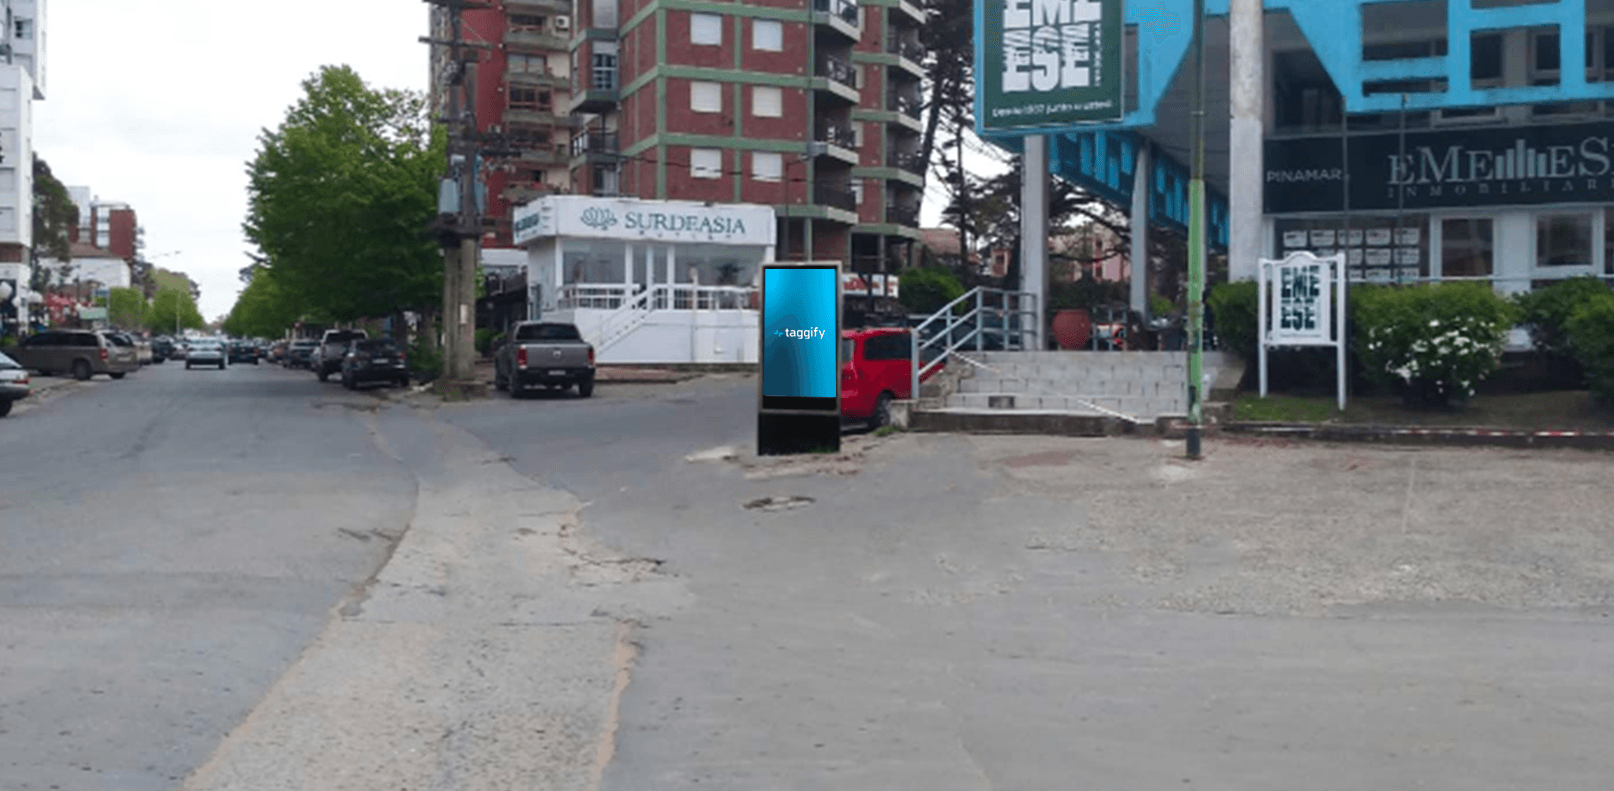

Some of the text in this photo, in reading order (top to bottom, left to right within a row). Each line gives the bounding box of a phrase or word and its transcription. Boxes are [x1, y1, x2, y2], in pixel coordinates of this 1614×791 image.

[1001, 23, 1090, 93] ESE
[1266, 168, 1342, 183] PINAMAR
[624, 211, 747, 234] SURDEASIA
[1280, 264, 1320, 298] EME
[1280, 298, 1316, 331] ESE
[784, 326, 826, 340] taggify
